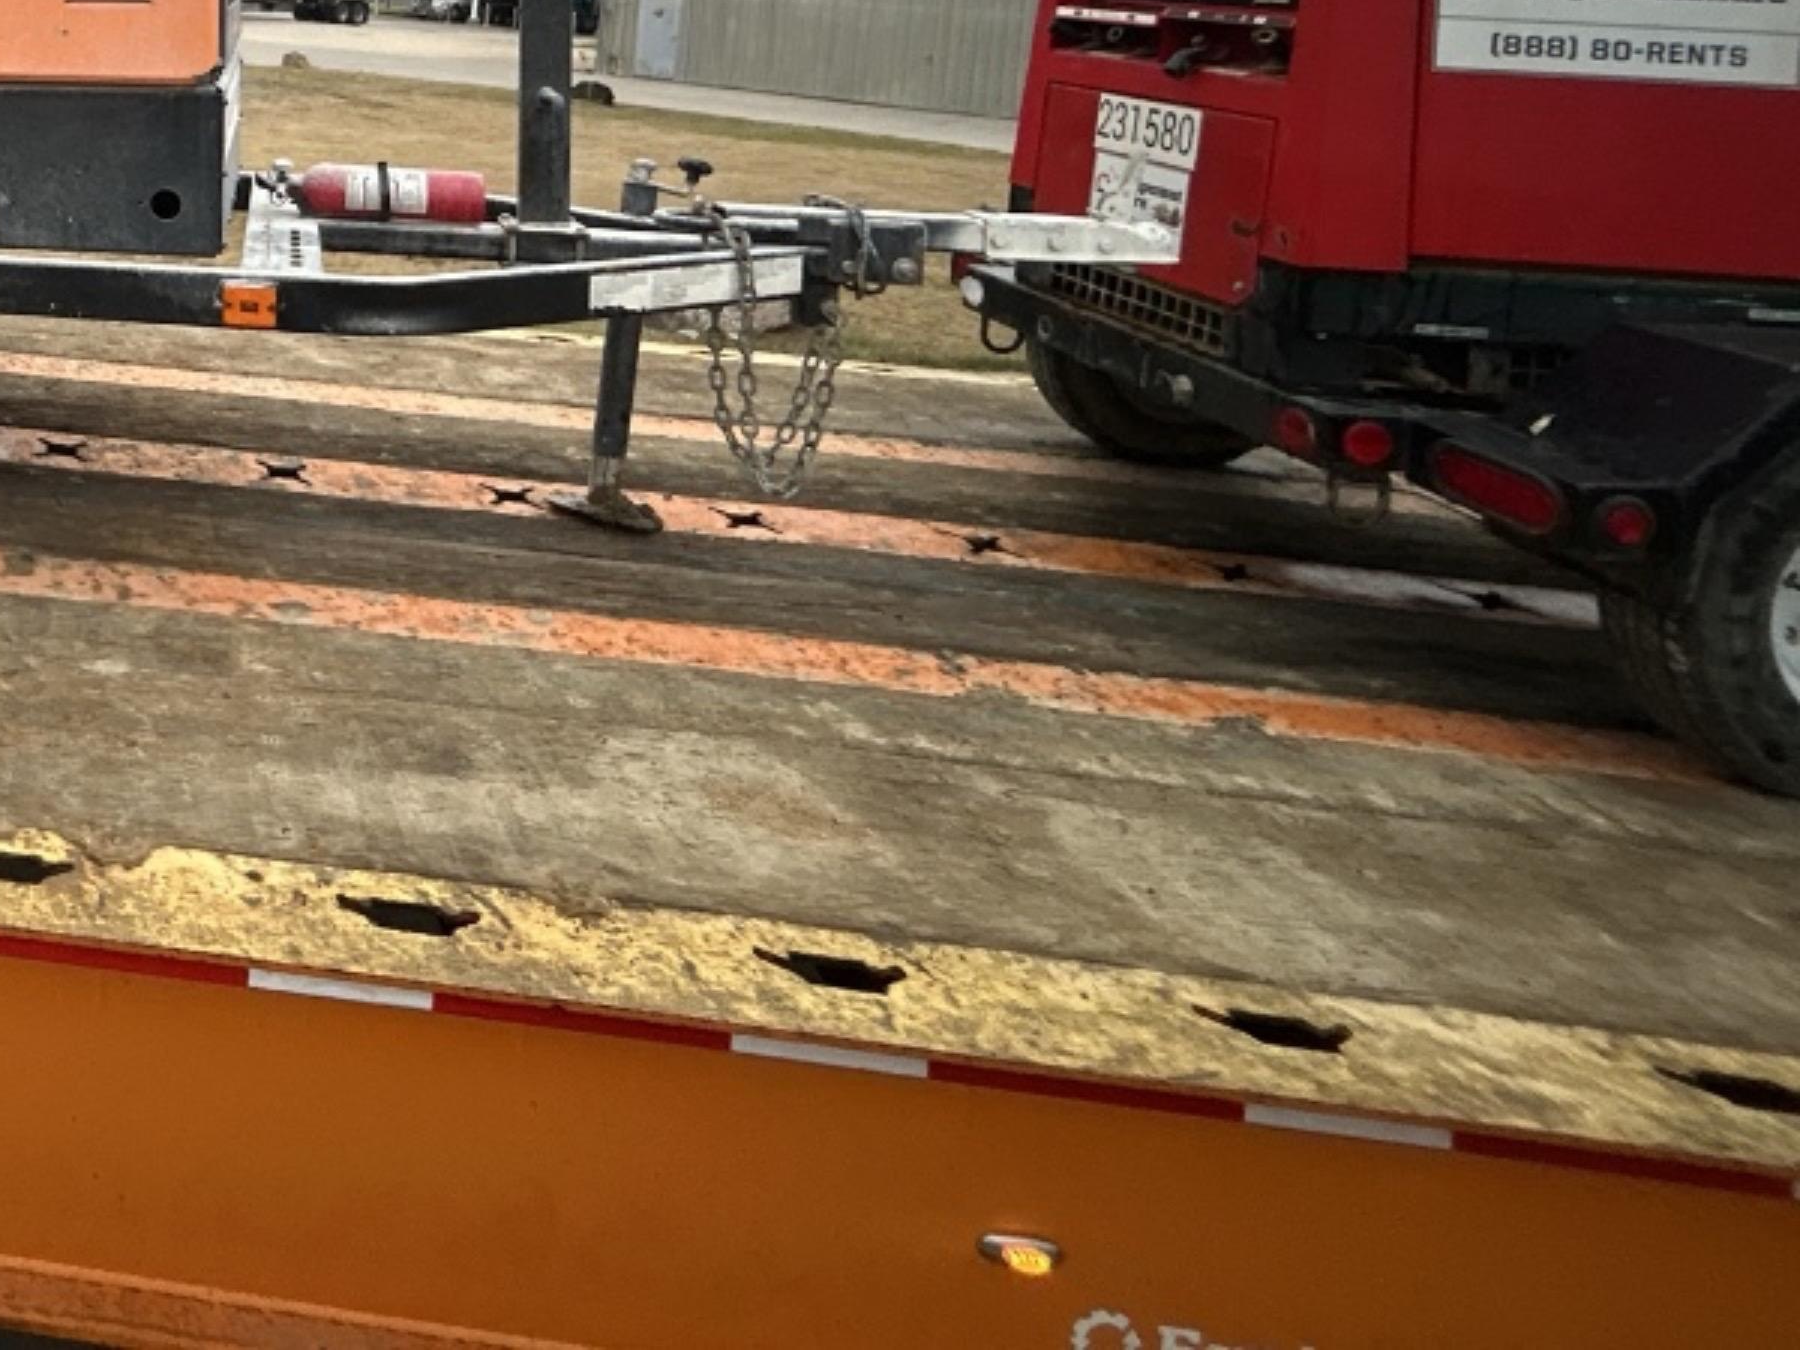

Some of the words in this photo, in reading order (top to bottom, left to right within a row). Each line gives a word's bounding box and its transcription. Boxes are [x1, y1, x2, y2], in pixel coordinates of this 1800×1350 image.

[1490, 32, 1579, 61] (888)
[1589, 38, 1748, 68] 80-RENTS
[1097, 98, 1195, 157] 231580
